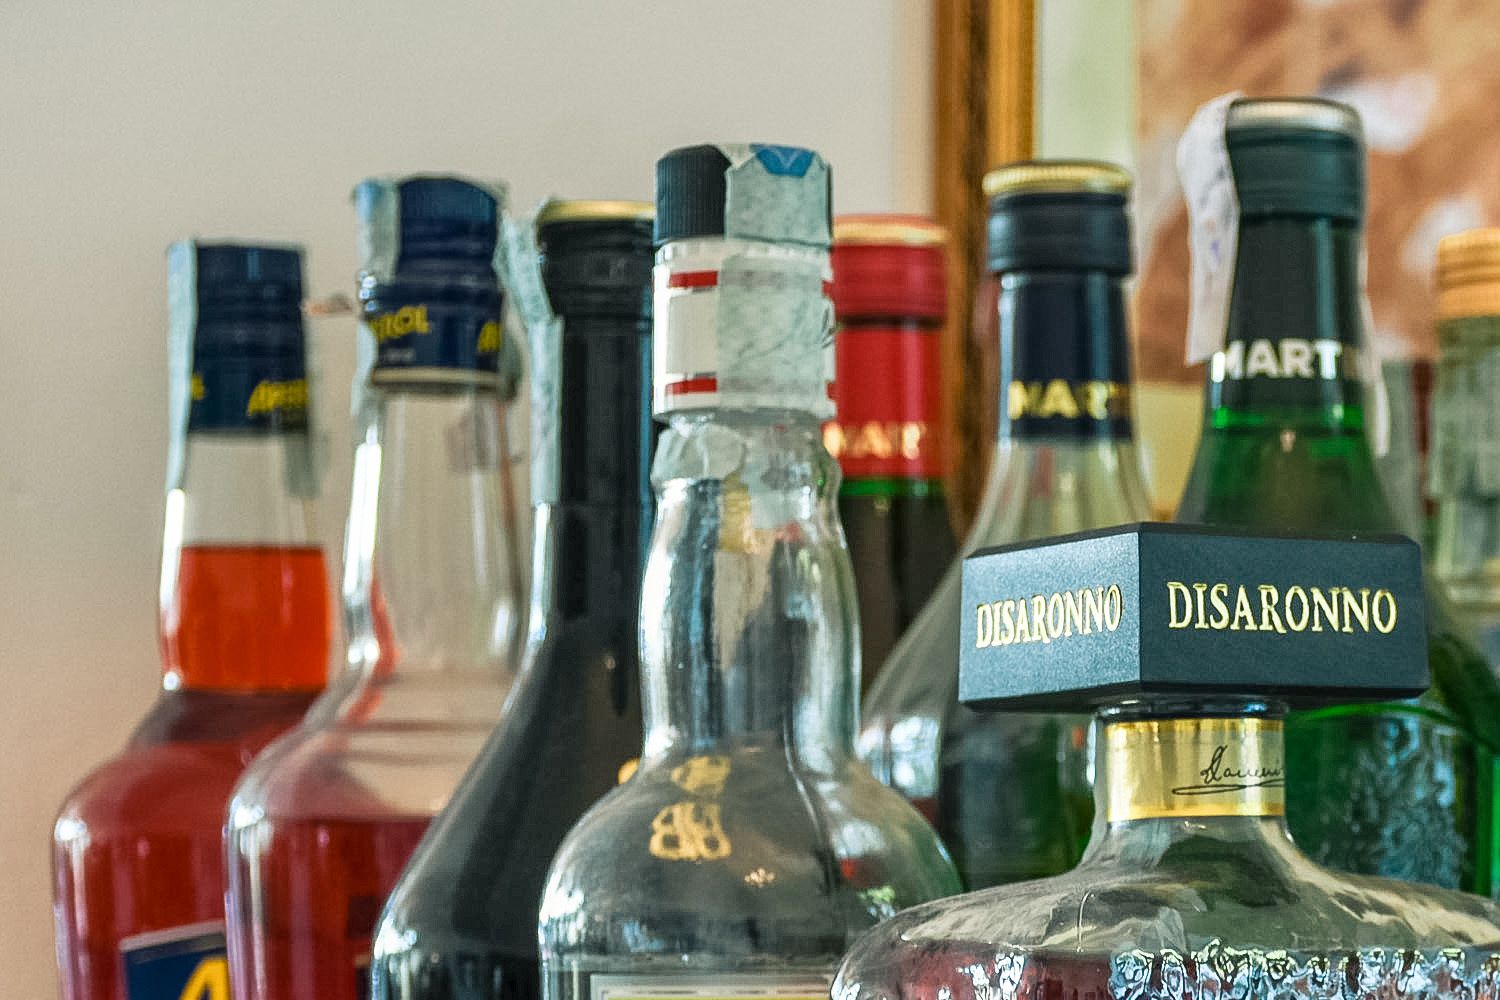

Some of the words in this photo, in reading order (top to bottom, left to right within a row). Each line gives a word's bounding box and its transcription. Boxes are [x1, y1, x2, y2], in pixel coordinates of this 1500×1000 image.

[1211, 338, 1357, 383] MART
[976, 583, 1123, 649] DISARONNO
[1167, 582, 1398, 634] DISARONNO
